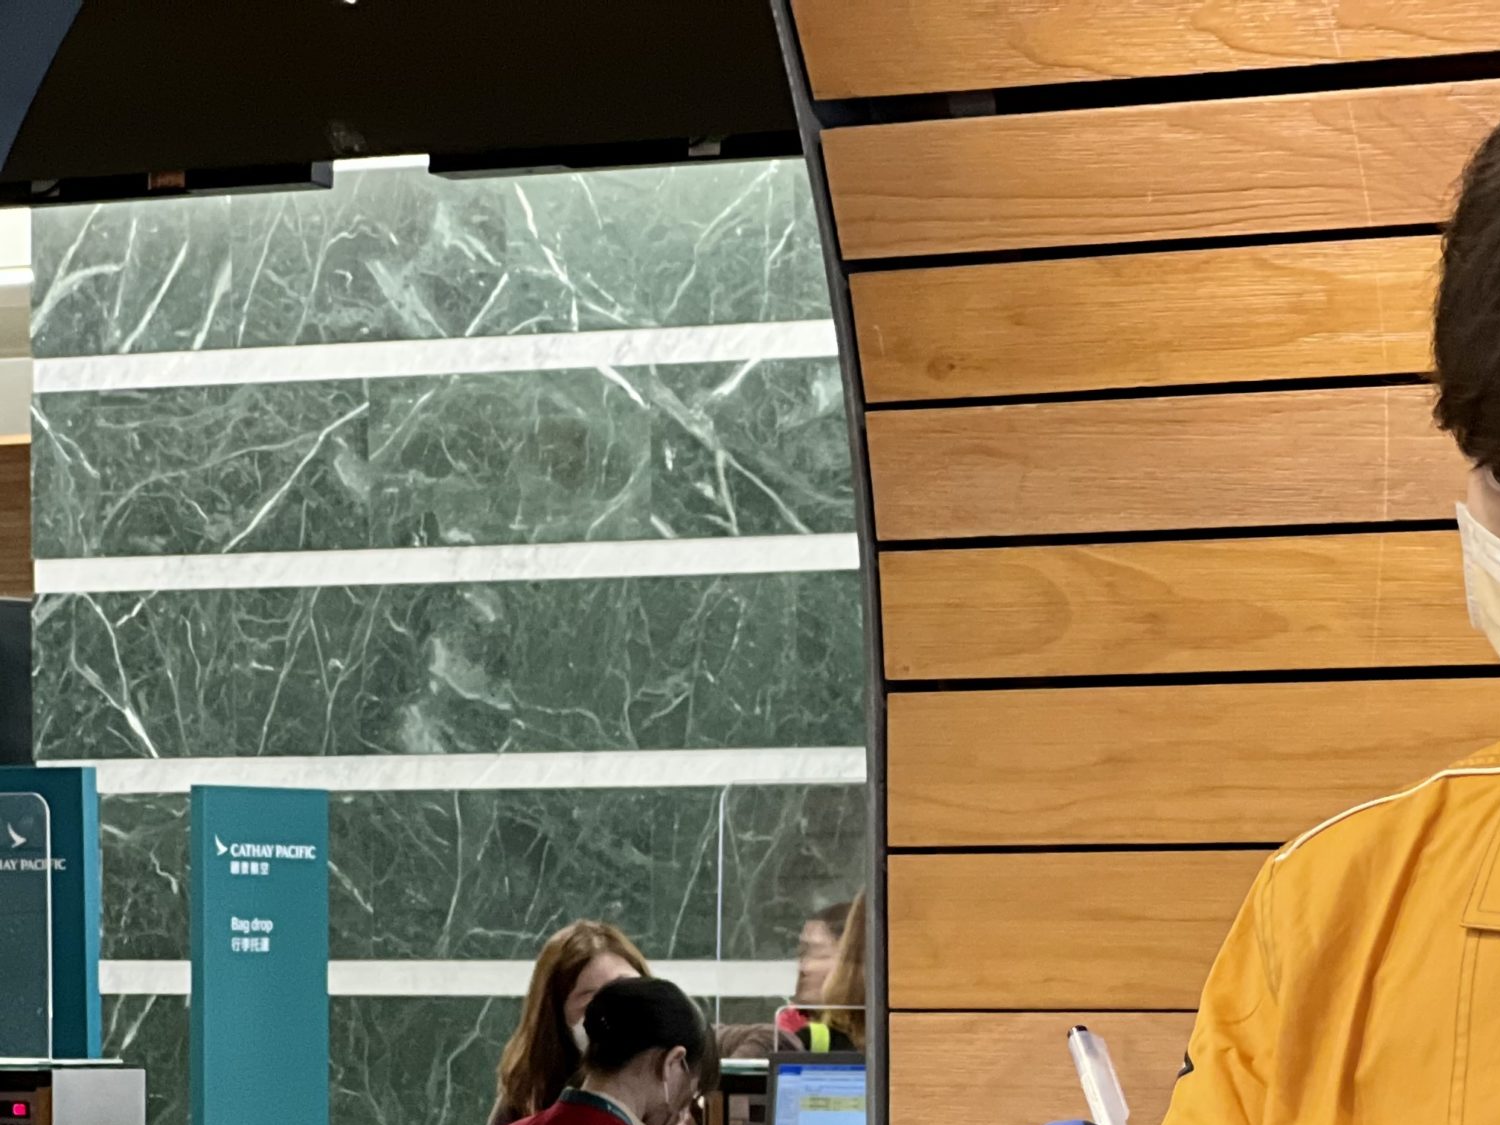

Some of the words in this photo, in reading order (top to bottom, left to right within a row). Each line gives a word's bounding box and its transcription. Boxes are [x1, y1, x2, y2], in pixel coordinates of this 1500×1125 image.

[230, 843, 273, 858] CATHAY
[275, 844, 316, 860] PACIFIC
[20, 858, 66, 871] PACIIC
[231, 916, 250, 934] Bag
[251, 917, 273, 934] drop
